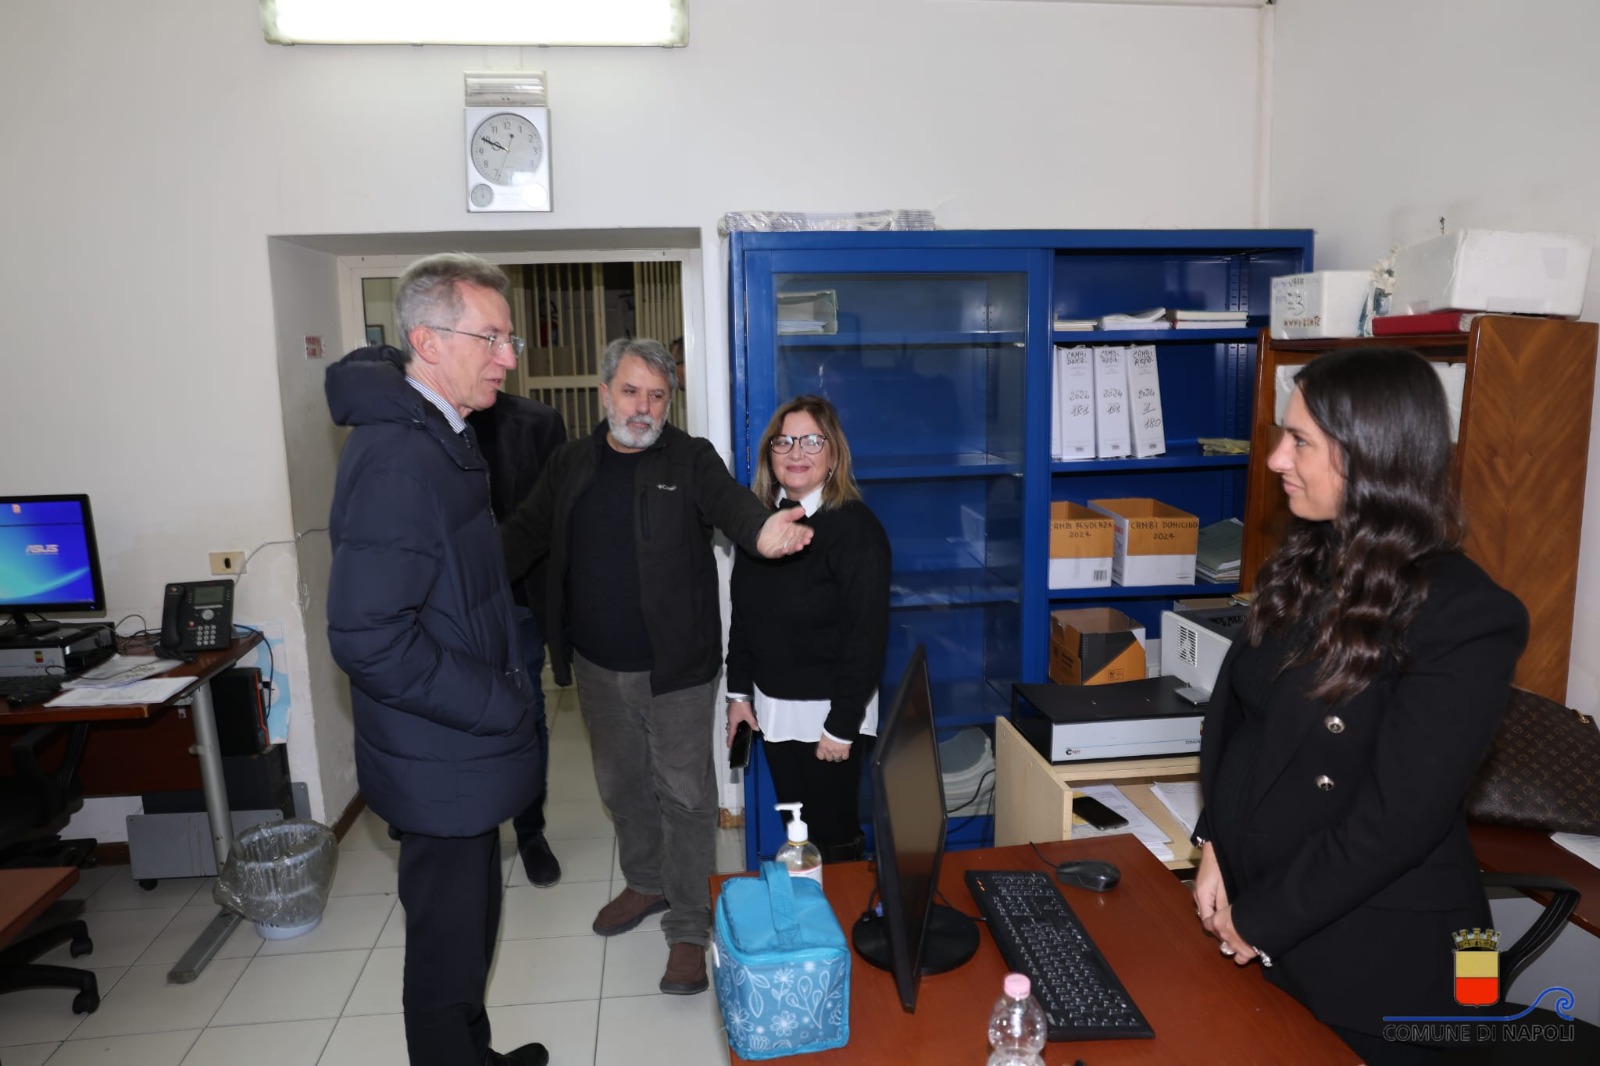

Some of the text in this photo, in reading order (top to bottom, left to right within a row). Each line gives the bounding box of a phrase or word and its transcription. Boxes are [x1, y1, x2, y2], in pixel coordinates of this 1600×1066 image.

[491, 126, 498, 134] 11
[503, 121, 512, 130] 12
[1130, 521, 1157, 530] CAMBI
[1153, 532, 1175, 540] 2024
[25, 544, 59, 555] ASUS
